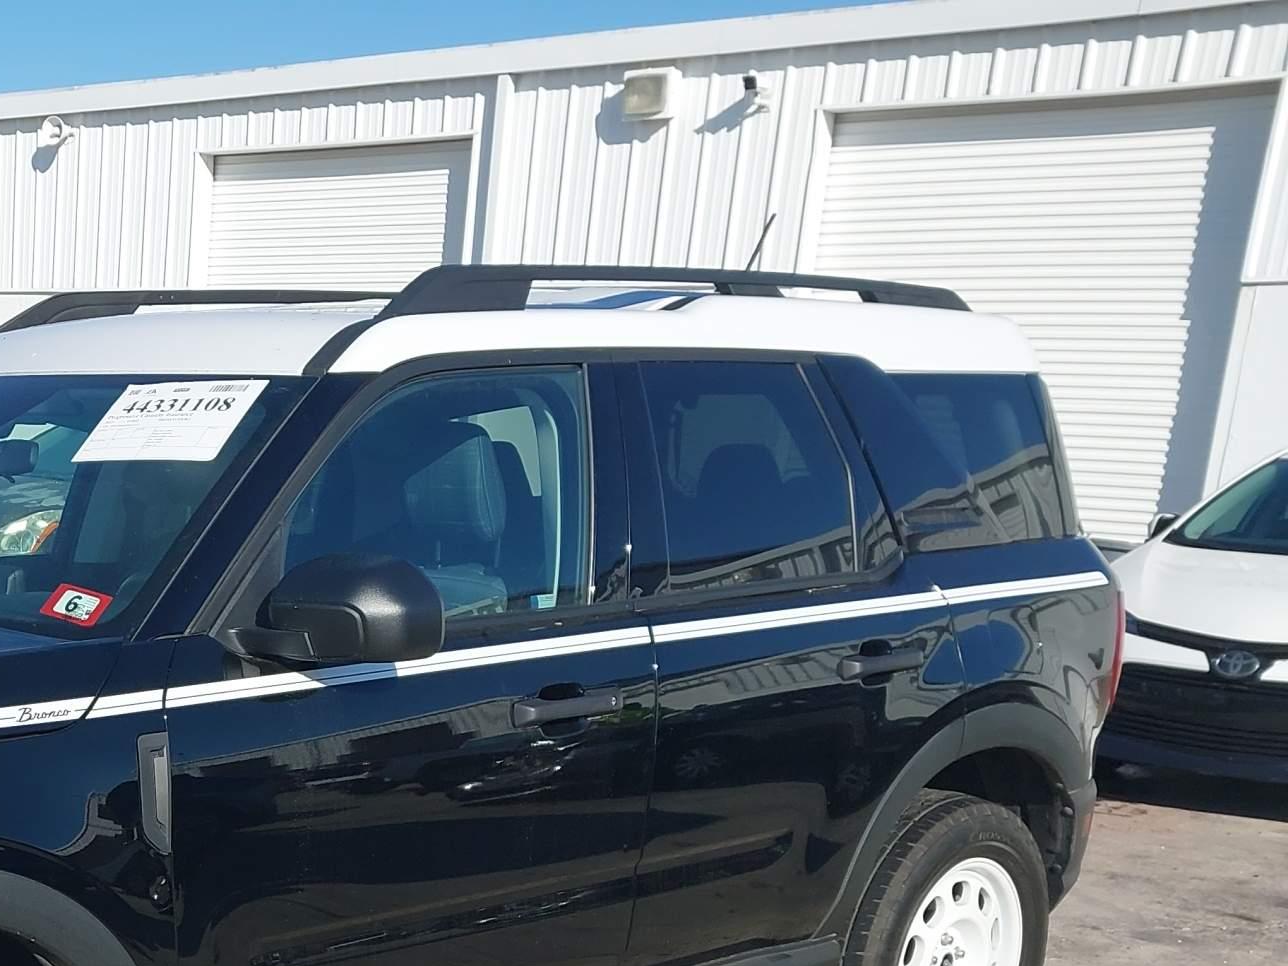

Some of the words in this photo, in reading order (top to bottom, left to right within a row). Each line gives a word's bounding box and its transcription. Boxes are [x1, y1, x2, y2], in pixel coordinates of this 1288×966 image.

[122, 397, 236, 413] 44331108
[64, 595, 83, 613] 6
[15, 707, 71, 722] Bronco
